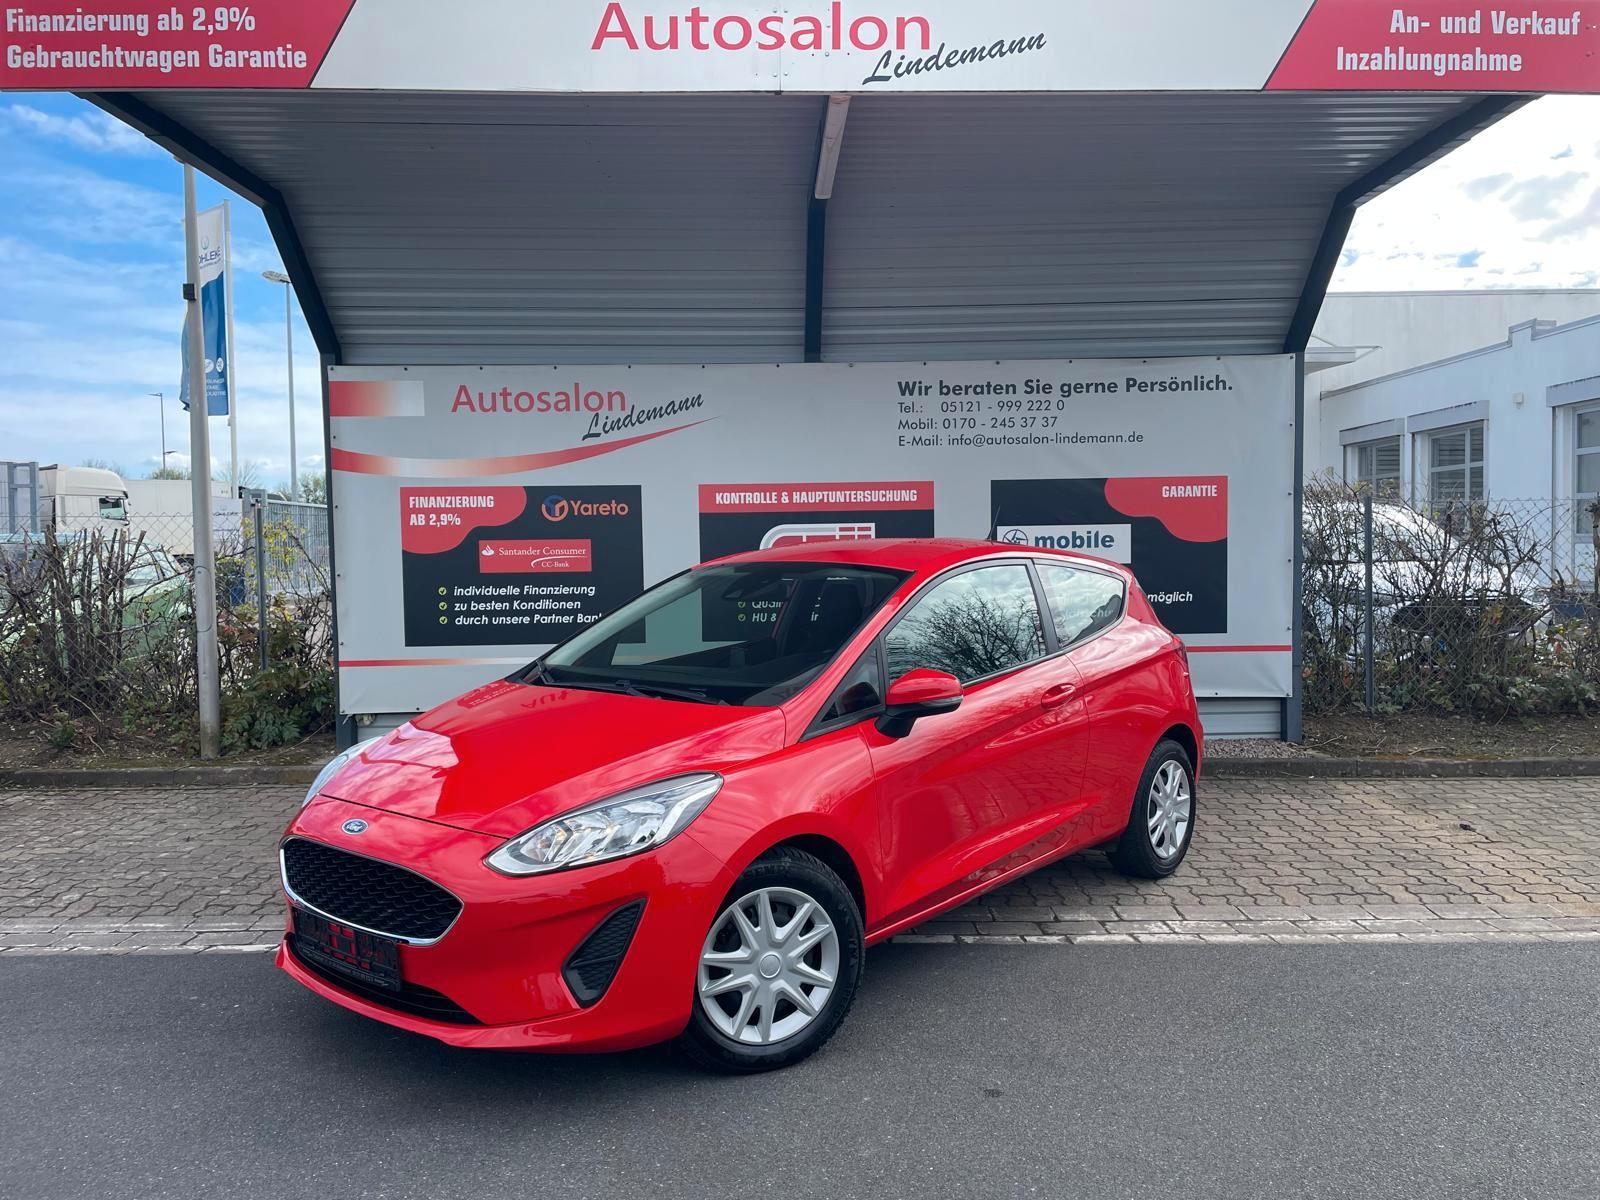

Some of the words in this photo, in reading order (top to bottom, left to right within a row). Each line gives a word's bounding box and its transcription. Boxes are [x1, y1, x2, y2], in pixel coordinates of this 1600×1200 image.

[6, 8, 149, 37] Finanzierung
[158, 7, 184, 31] ab
[192, 7, 256, 35] 2,9%
[591, 1, 931, 51] Autosalon
[1390, 10, 1430, 33] An-
[1440, 10, 1481, 34] und
[1490, 11, 1581, 35] Verkauf
[6, 44, 200, 73] Gebrauchtwagen
[208, 44, 307, 68] Garantie
[862, 32, 1047, 85] Lindemann
[1336, 46, 1522, 76] Inzahlungnahme
[898, 381, 932, 397] Wir
[939, 380, 1017, 396] beraten
[1023, 379, 1053, 395] Sie
[1060, 380, 1118, 398] gerne
[1126, 375, 1233, 393] Persönlich.
[451, 383, 626, 413] Autosalon
[898, 401, 923, 414] Tel.:
[941, 401, 982, 413] 05121
[998, 400, 1022, 413] 999
[1027, 400, 1052, 412] 222
[1056, 399, 1065, 412] 0
[582, 392, 704, 441] Lindemann
[898, 417, 938, 431] Mobil:
[942, 417, 976, 430] 0170
[990, 417, 1016, 429] 245
[1020, 416, 1037, 428] 37
[1041, 416, 1058, 428] 37
[898, 433, 943, 447] E-Mail:
[948, 431, 1144, 447] info@autosalon-lindemann.de
[715, 492, 778, 505] KONTROLLE
[781, 491, 789, 504] &
[793, 490, 918, 503] HAUPTUNTERSUCHUNG
[1162, 485, 1218, 498] GARANTIE
[409, 495, 494, 509] FINANZIERUNG
[571, 499, 629, 516] Yareto
[410, 514, 425, 526] AB
[429, 513, 461, 528] 2,9%
[1034, 530, 1115, 549] mobile
[499, 547, 541, 556] Santander
[543, 546, 586, 555] Consumer
[541, 560, 570, 568] CC-Bank
[454, 585, 520, 597] individuelle
[524, 584, 596, 597] Finanzierung
[1147, 591, 1193, 604] möglich
[454, 602, 468, 611] zu
[471, 600, 510, 611] besten
[513, 599, 581, 610] Konditionen
[455, 615, 489, 625] durch
[492, 615, 530, 625] unsere
[534, 613, 575, 624] Partner
[752, 613, 767, 622] HU
